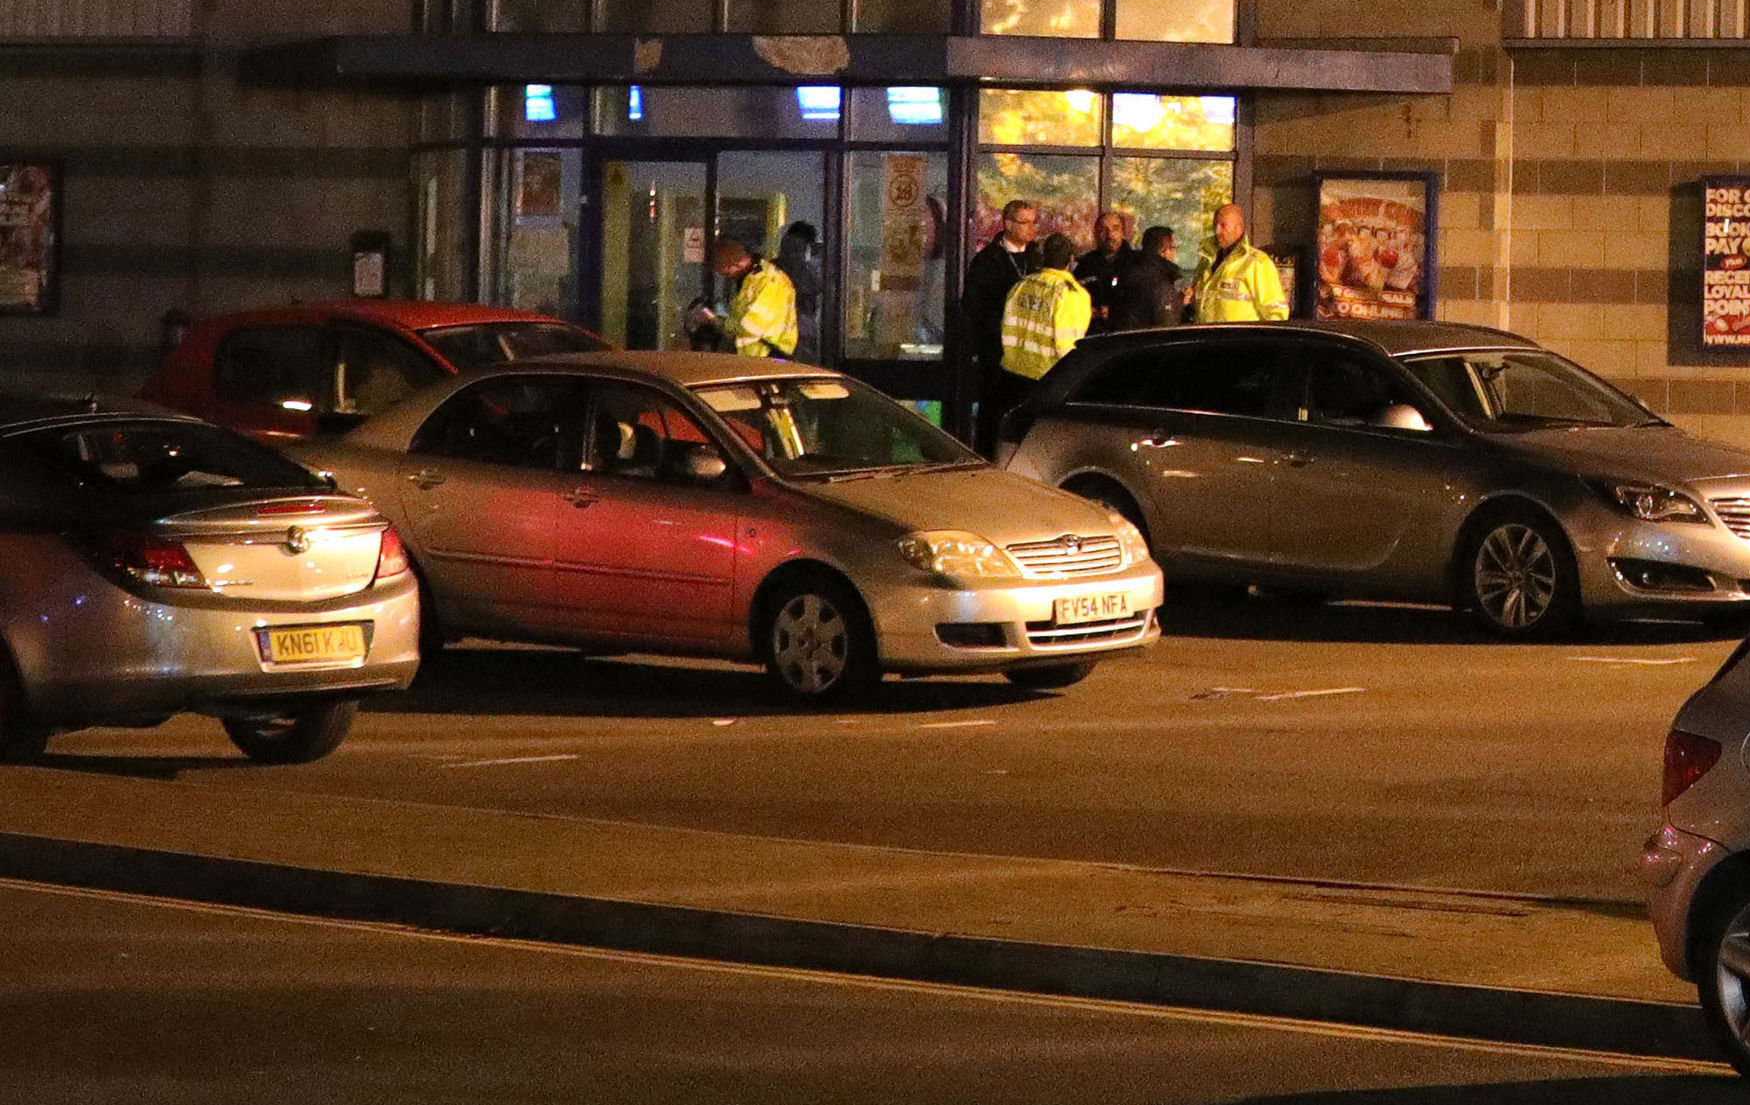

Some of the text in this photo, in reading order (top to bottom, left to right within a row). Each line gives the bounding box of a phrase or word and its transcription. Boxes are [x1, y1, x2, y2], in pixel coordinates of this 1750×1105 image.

[1706, 189, 1741, 203] FOR
[1706, 237, 1742, 254] PAY
[1060, 594, 1128, 620] FV54 NFA
[276, 633, 320, 656] KN61
